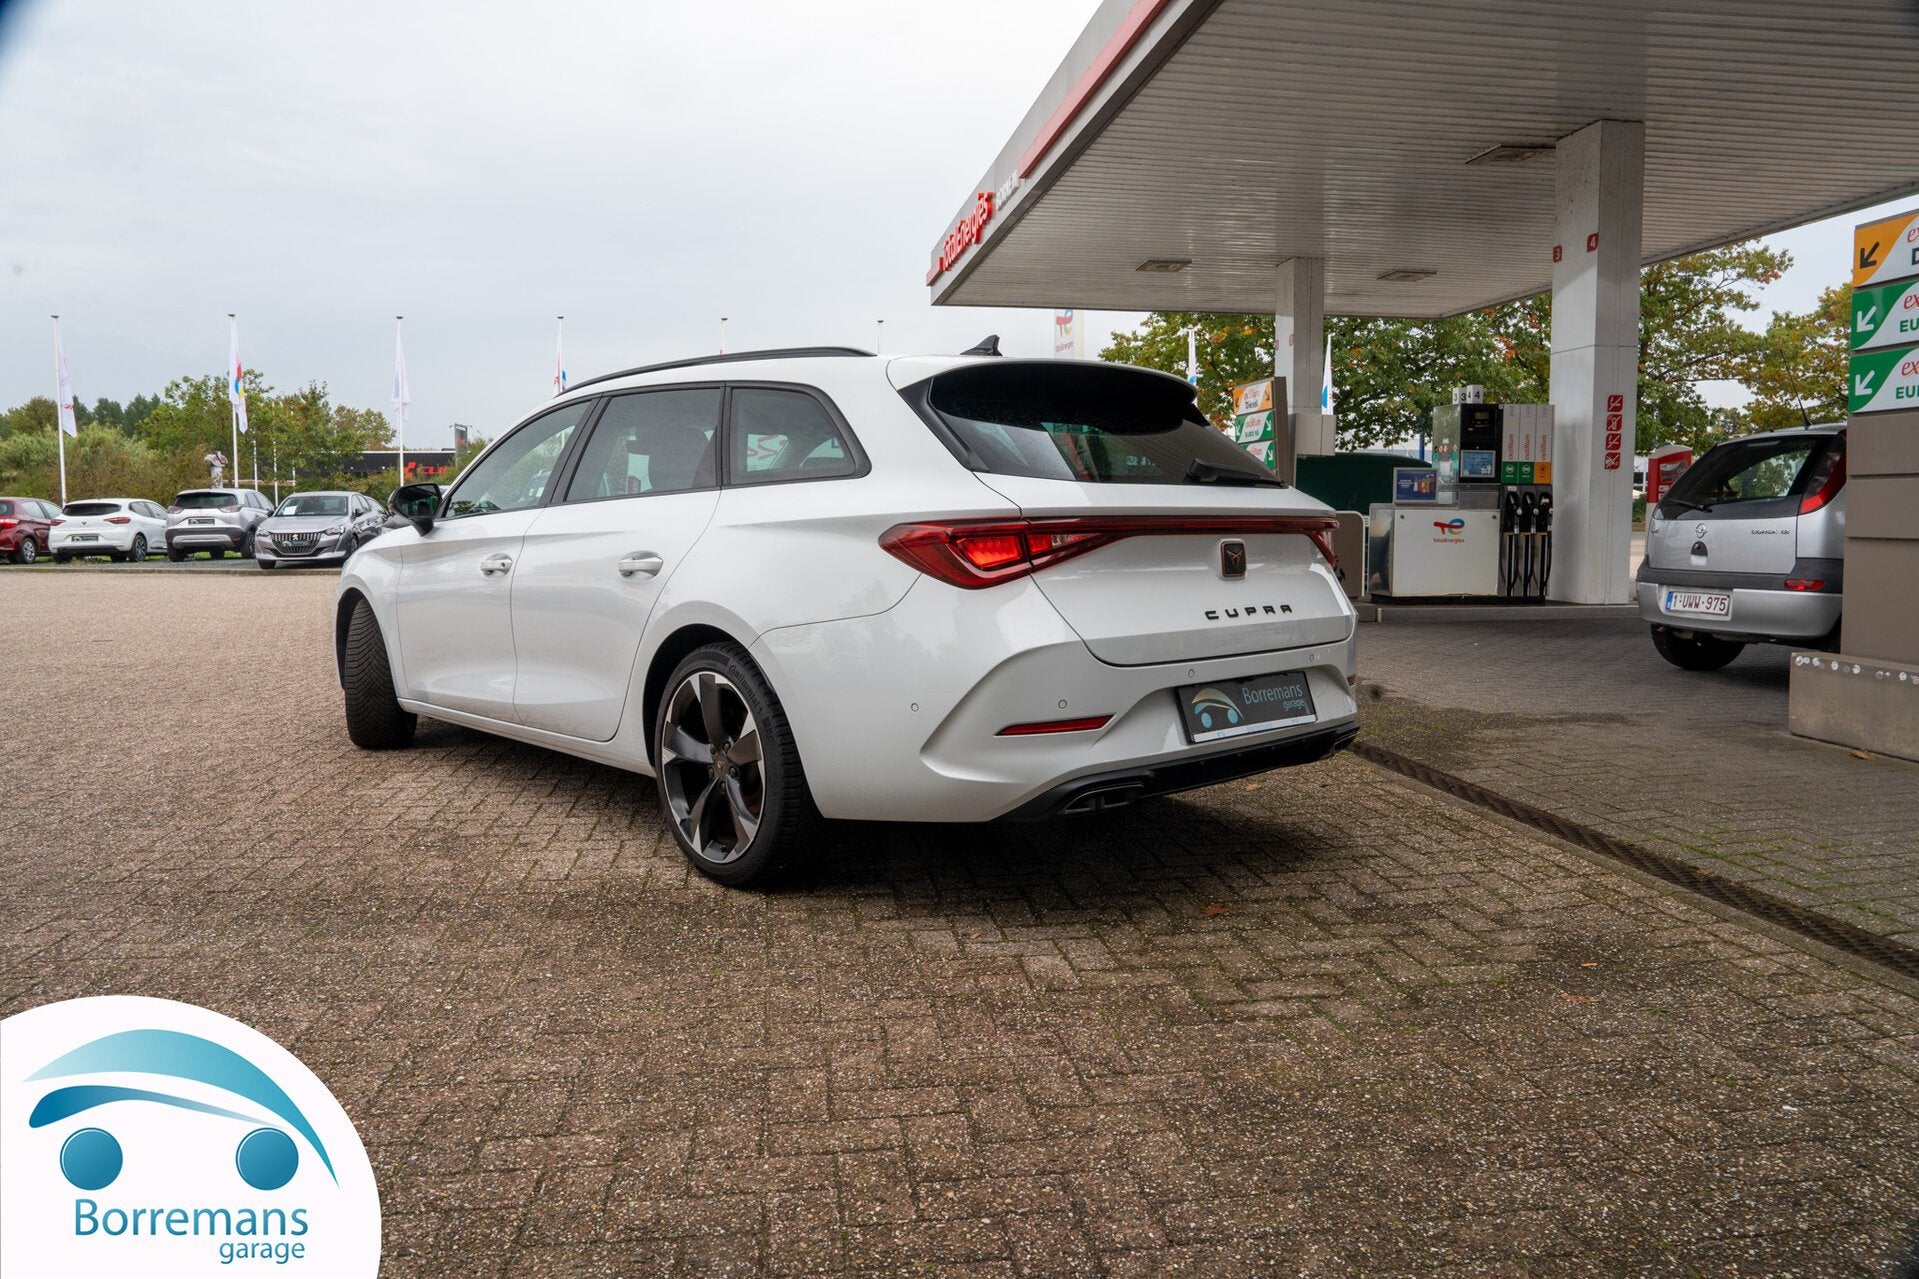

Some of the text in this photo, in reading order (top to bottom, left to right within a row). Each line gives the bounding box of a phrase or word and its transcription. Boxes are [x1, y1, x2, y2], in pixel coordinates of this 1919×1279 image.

[1461, 392, 1467, 401] 3
[1474, 391, 1480, 399] 4
[1205, 604, 1293, 620] CUPRA
[1242, 684, 1303, 704] Borremans
[1283, 699, 1305, 711] garage
